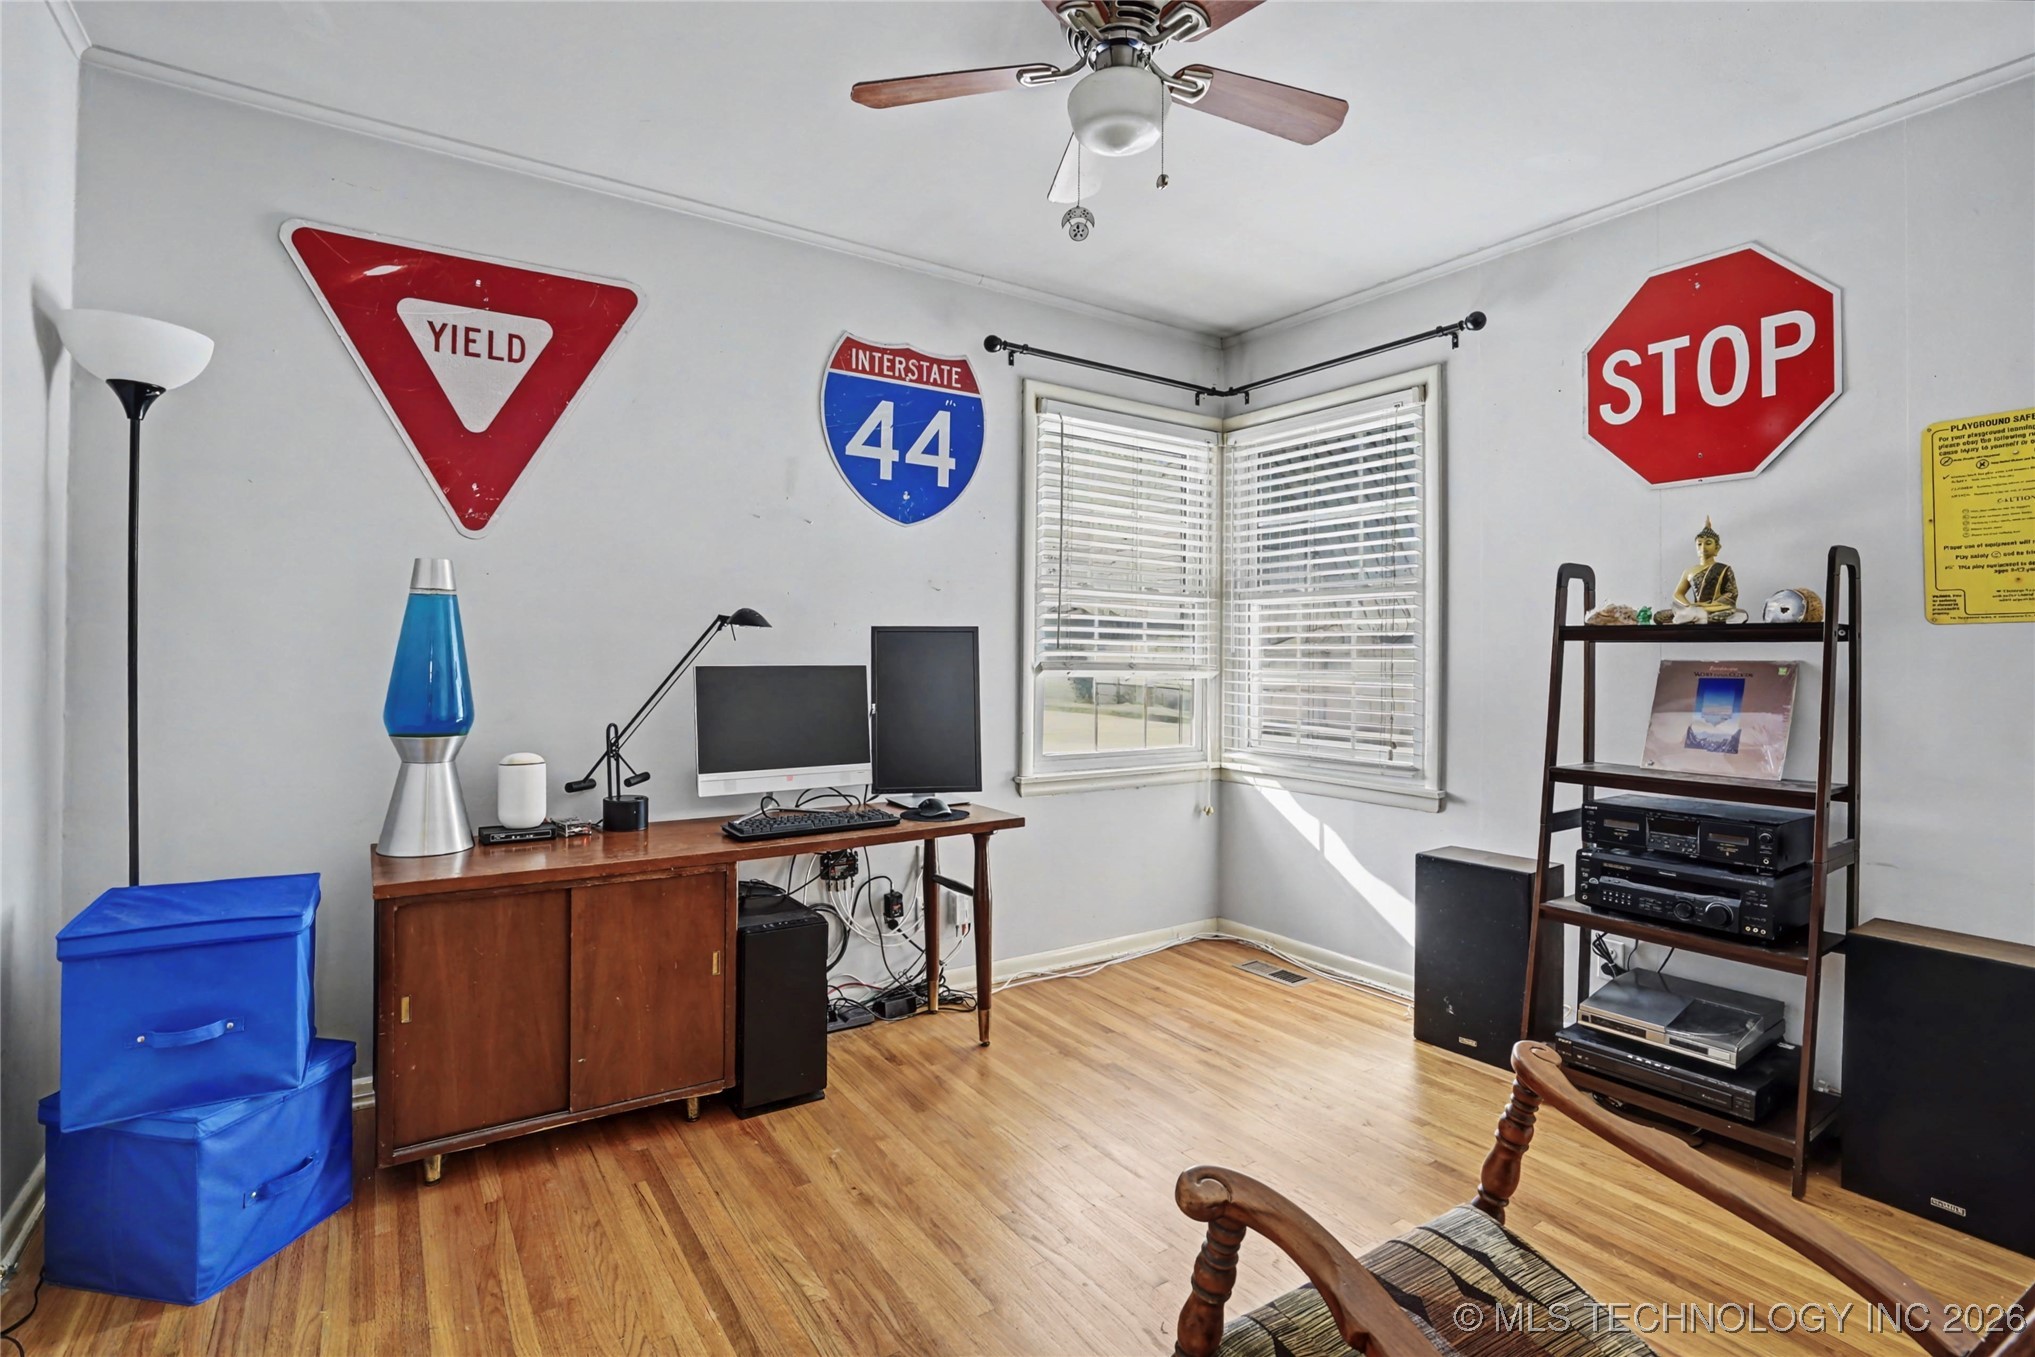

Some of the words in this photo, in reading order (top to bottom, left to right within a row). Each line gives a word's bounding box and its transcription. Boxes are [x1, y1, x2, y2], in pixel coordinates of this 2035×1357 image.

[427, 320, 526, 364] YIELD
[852, 348, 962, 388] INTERSTATE
[1600, 310, 1816, 425] STOP
[1950, 417, 2010, 432] PLAYGROUND
[1967, 428, 2006, 439] playground
[1993, 432, 2026, 441] following
[845, 400, 956, 488] 44
[1990, 442, 2019, 450] yourself
